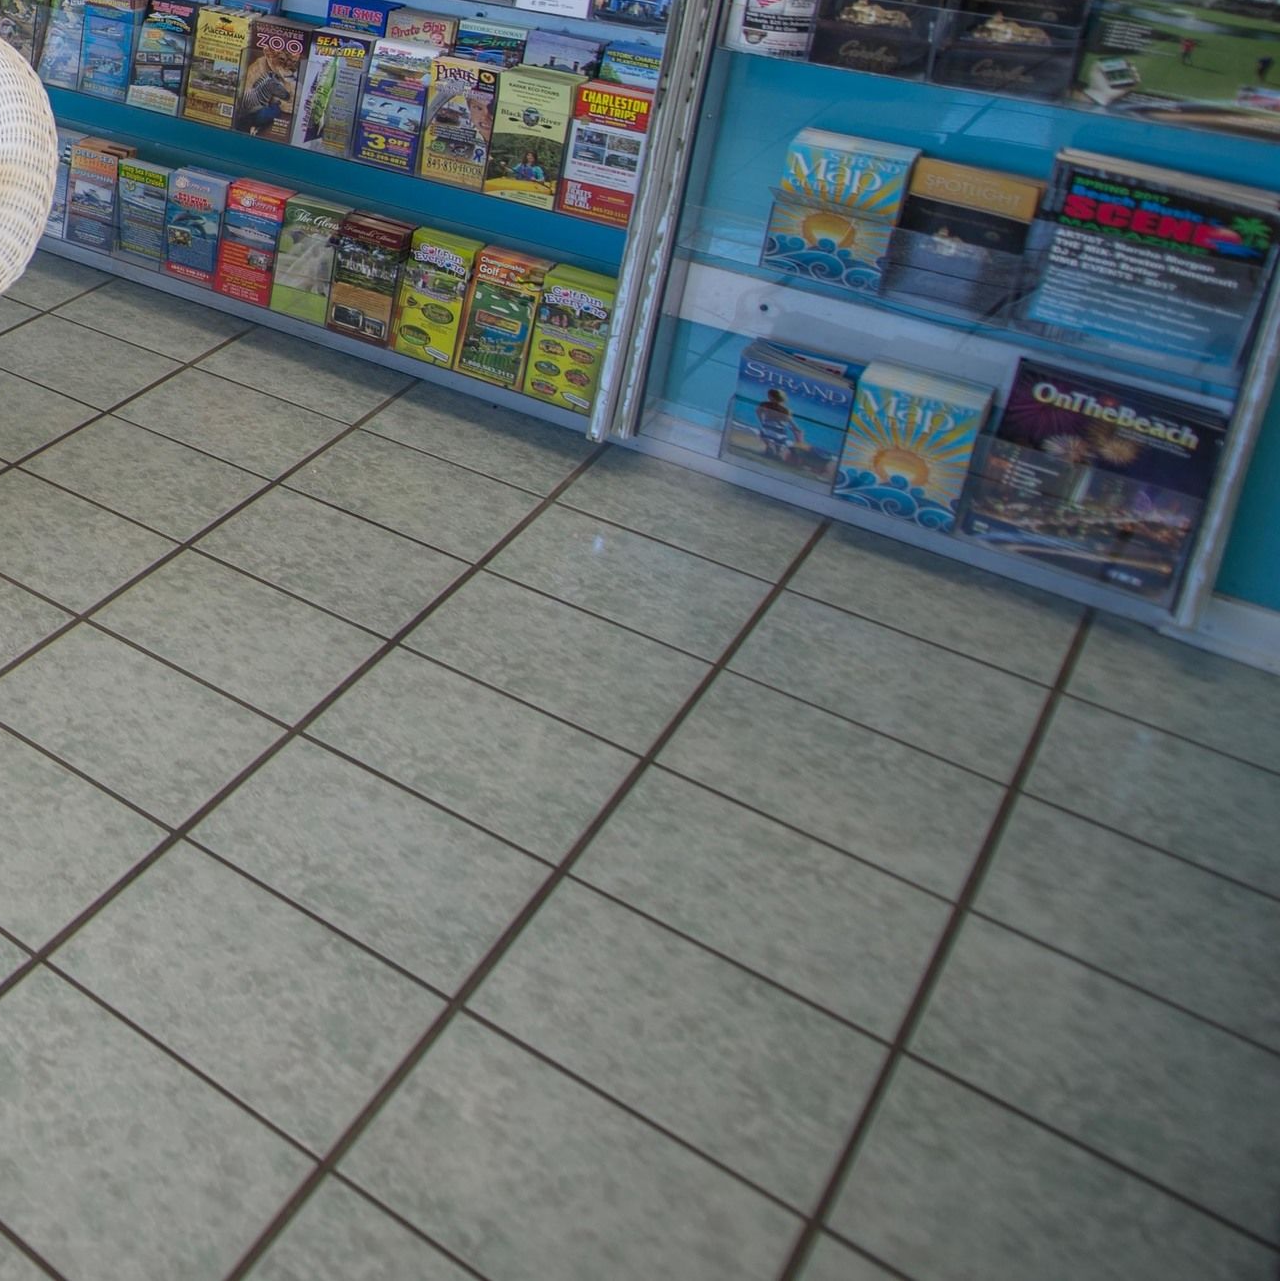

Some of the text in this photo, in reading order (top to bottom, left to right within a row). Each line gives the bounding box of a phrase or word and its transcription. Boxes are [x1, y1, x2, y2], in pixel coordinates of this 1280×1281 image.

[330, 3, 383, 24] JET SKIS
[256, 32, 304, 55] ZOO
[316, 35, 339, 48] SEA
[582, 89, 649, 114] CHARLESTON
[590, 103, 637, 121] DAY TRIPS
[789, 151, 882, 195] Map
[925, 173, 1021, 203] SPOTLIGHT
[414, 251, 466, 276] Everyone
[479, 263, 501, 277] Golf
[545, 293, 608, 320] Everyone
[744, 360, 849, 406] STRAND
[1032, 381, 1200, 450] OnTheBeach
